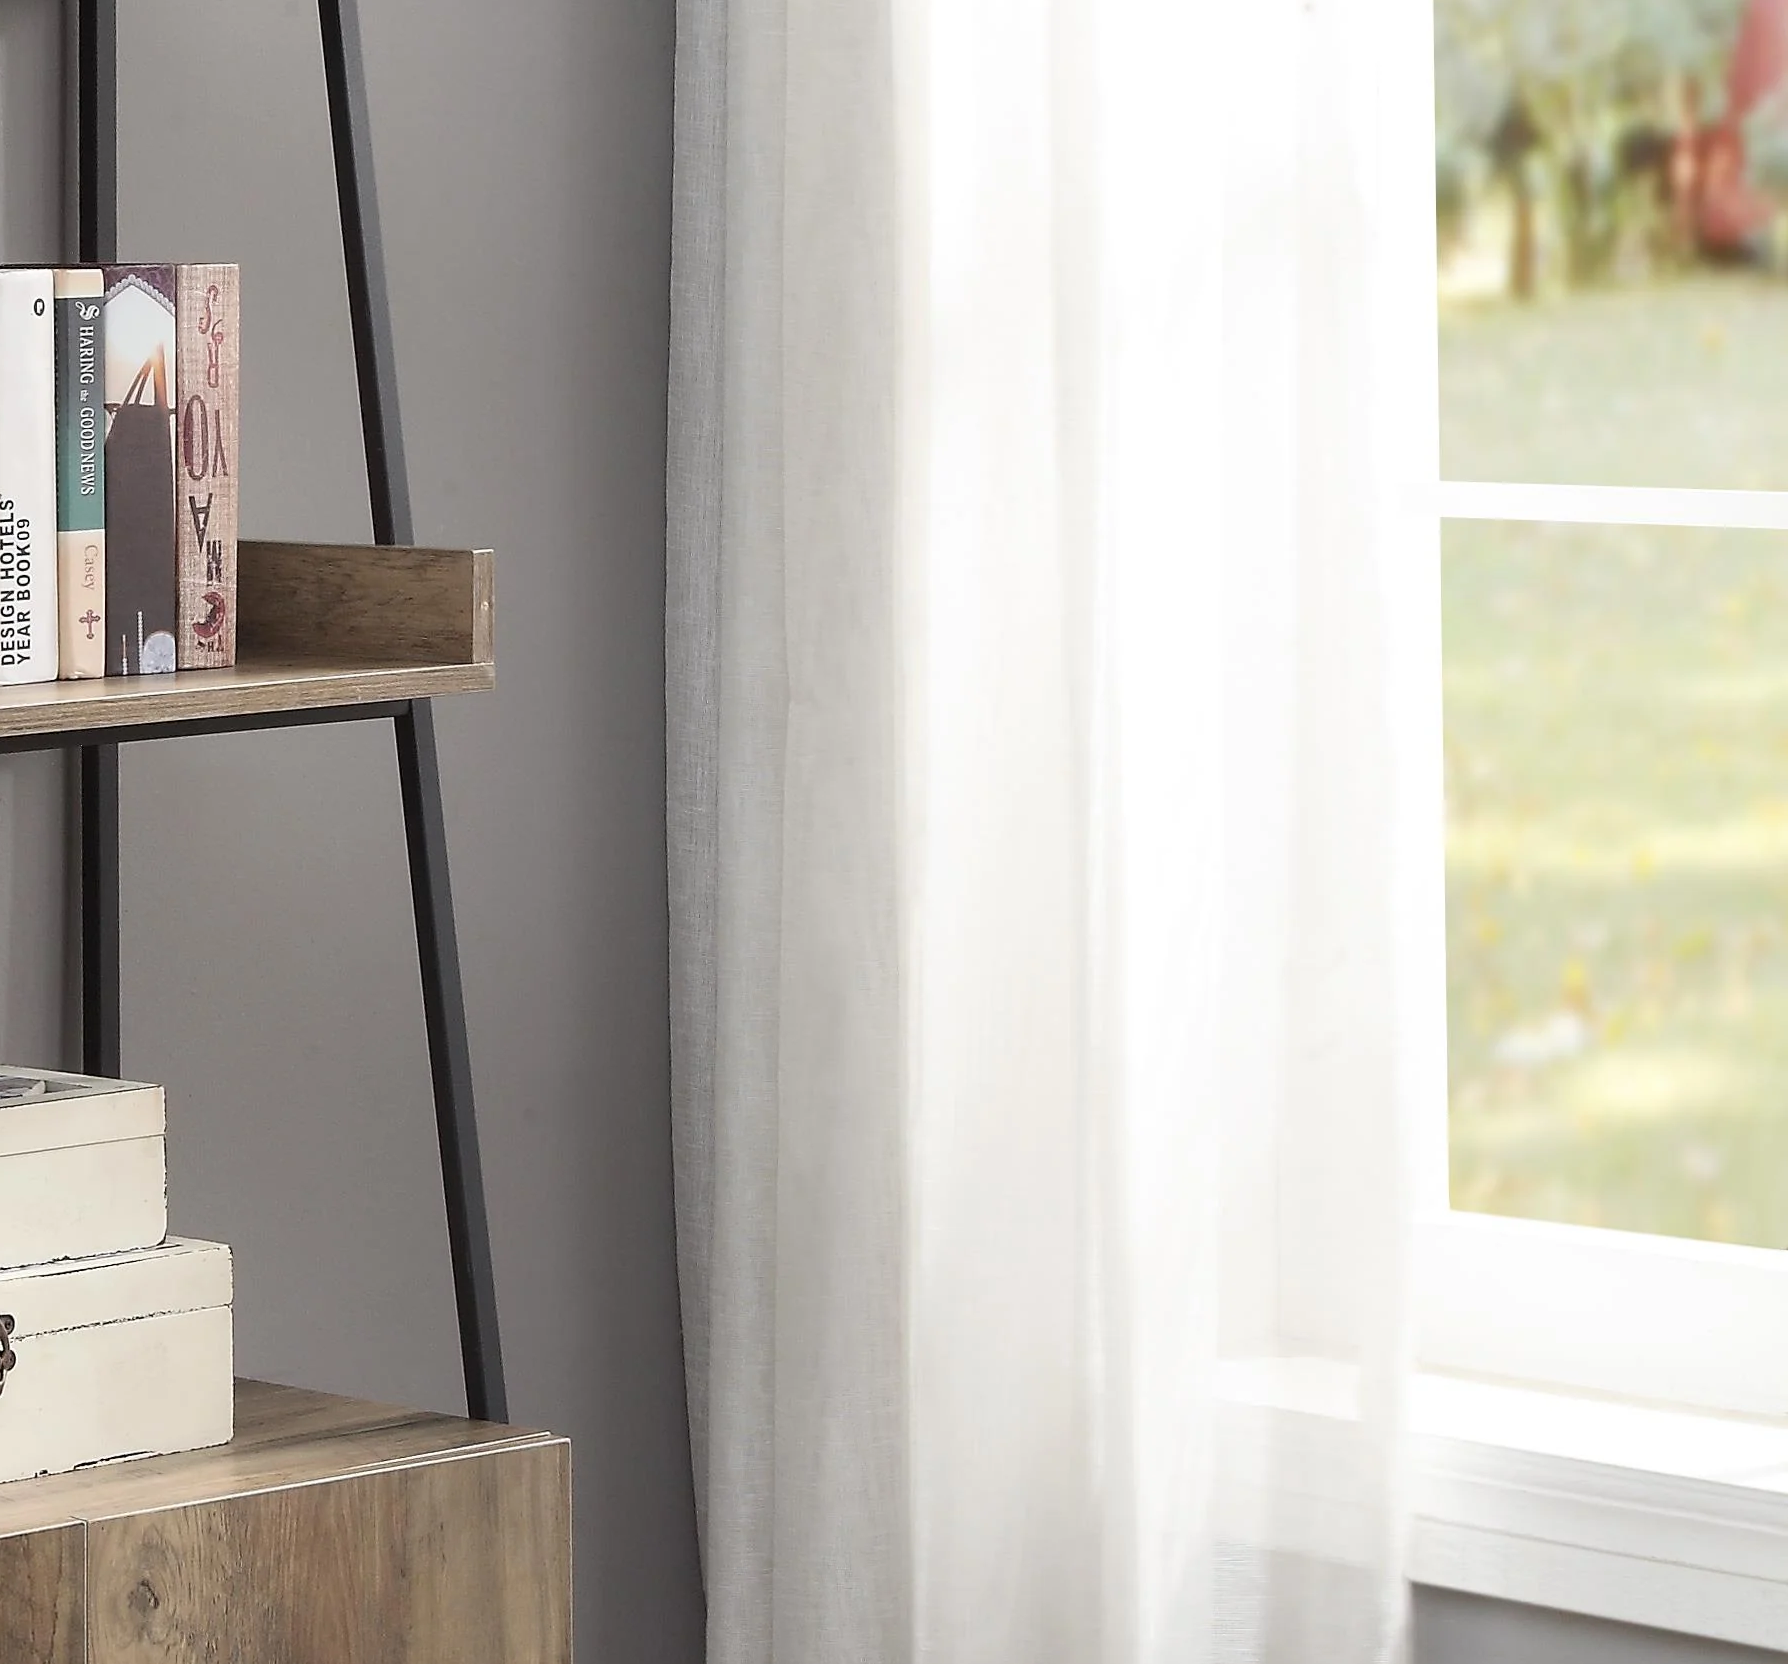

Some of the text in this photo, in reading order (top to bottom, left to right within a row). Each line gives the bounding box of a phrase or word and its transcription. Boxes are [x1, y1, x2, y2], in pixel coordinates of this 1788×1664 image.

[79, 407, 95, 451] GOOD
[79, 453, 95, 495] NEWS
[81, 544, 99, 591] Casey
[0, 590, 15, 666] DESIGN
[16, 610, 31, 665] YEAR
